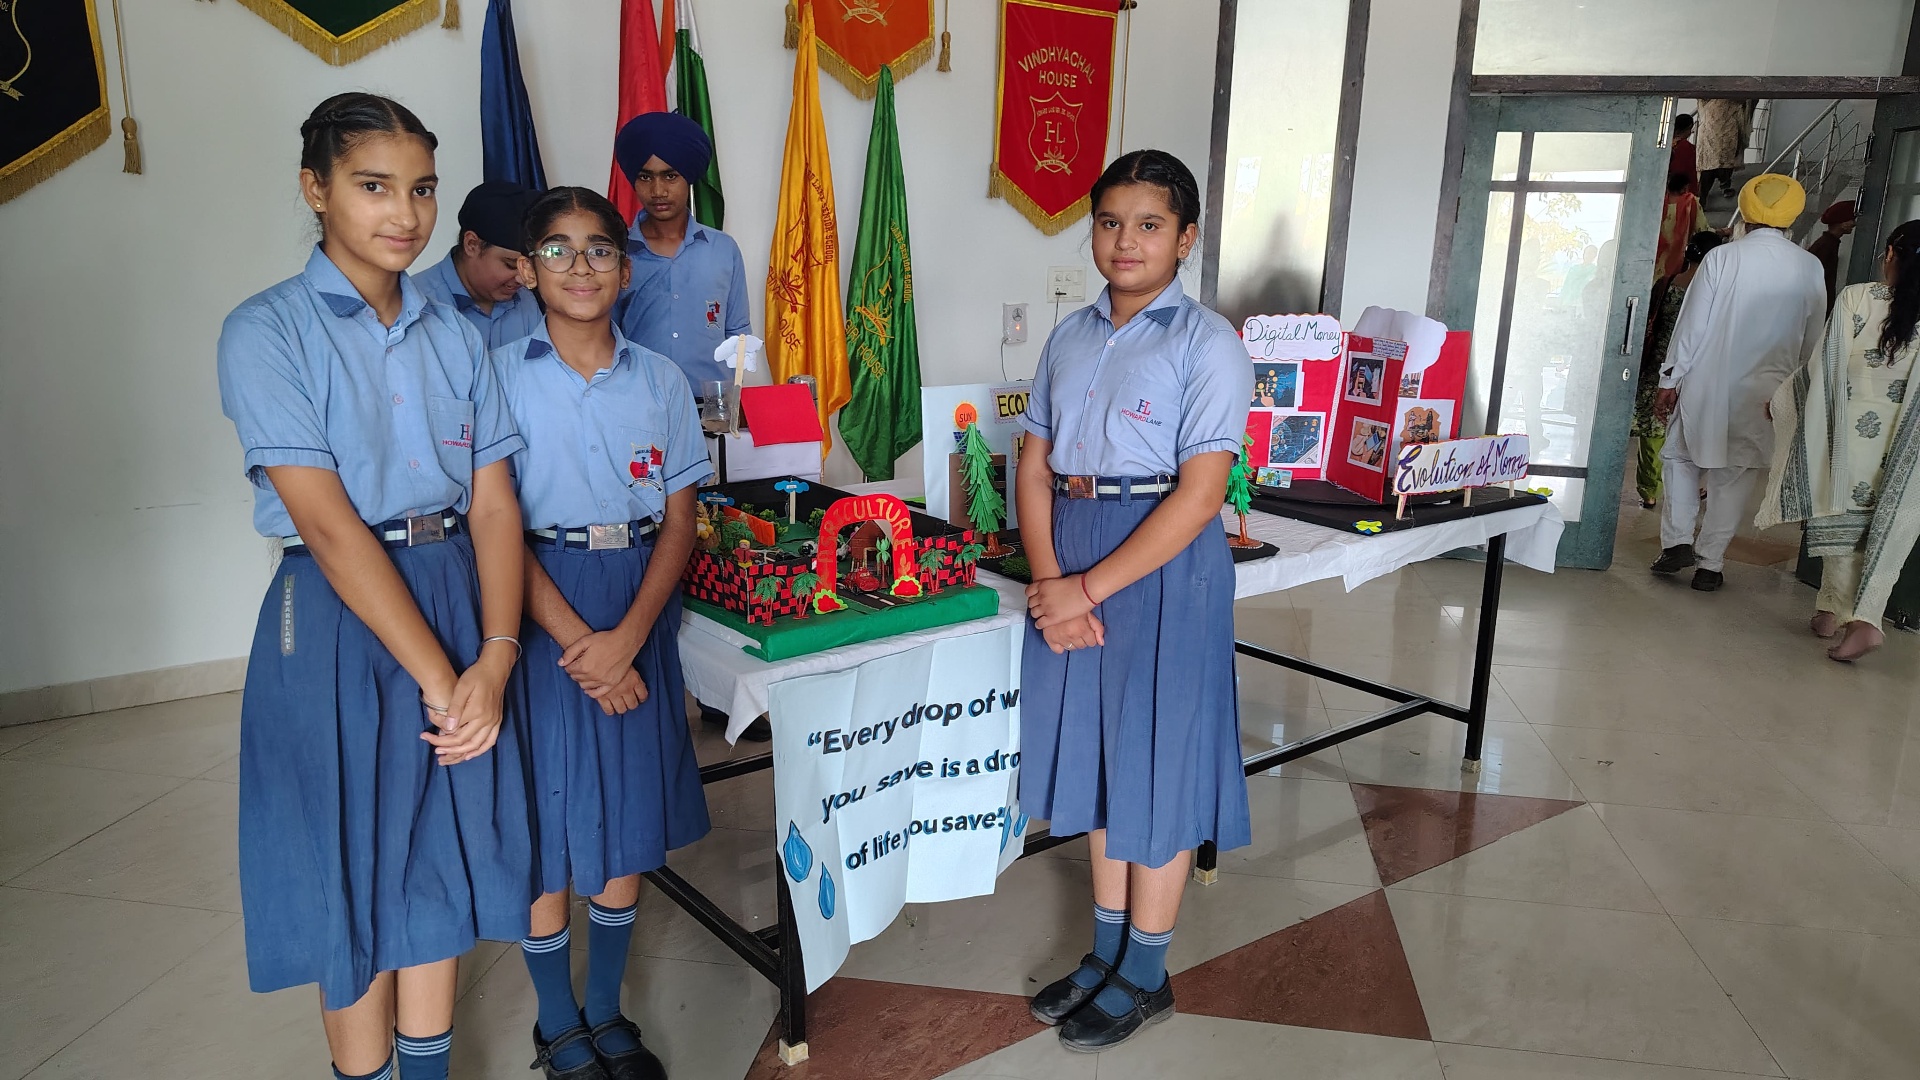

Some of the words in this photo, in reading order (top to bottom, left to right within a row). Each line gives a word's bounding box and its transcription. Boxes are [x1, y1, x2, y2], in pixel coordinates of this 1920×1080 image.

[1018, 46, 1095, 84] VINDHYACHAL
[1038, 70, 1078, 88] HOUSE
[821, 202, 833, 232] SENIOR
[824, 234, 834, 264] SCHOOL
[903, 274, 912, 303] SCHOOL
[779, 317, 801, 352] OUSE
[1246, 318, 1301, 356] Digital
[1301, 320, 1341, 355] Money
[857, 342, 886, 380] HOUSE
[959, 412, 973, 423] SUN
[1397, 444, 1476, 492] Evolution
[1476, 439, 1496, 487] of
[284, 587, 292, 650] HOWARDLANE
[901, 702, 963, 727] drop
[968, 688, 996, 717] of
[821, 785, 867, 824] you
[875, 760, 934, 792] save
[940, 757, 961, 778] is
[965, 758, 981, 775] a
[984, 749, 1020, 773] dro
[845, 841, 869, 870] of
[872, 831, 901, 861] life
